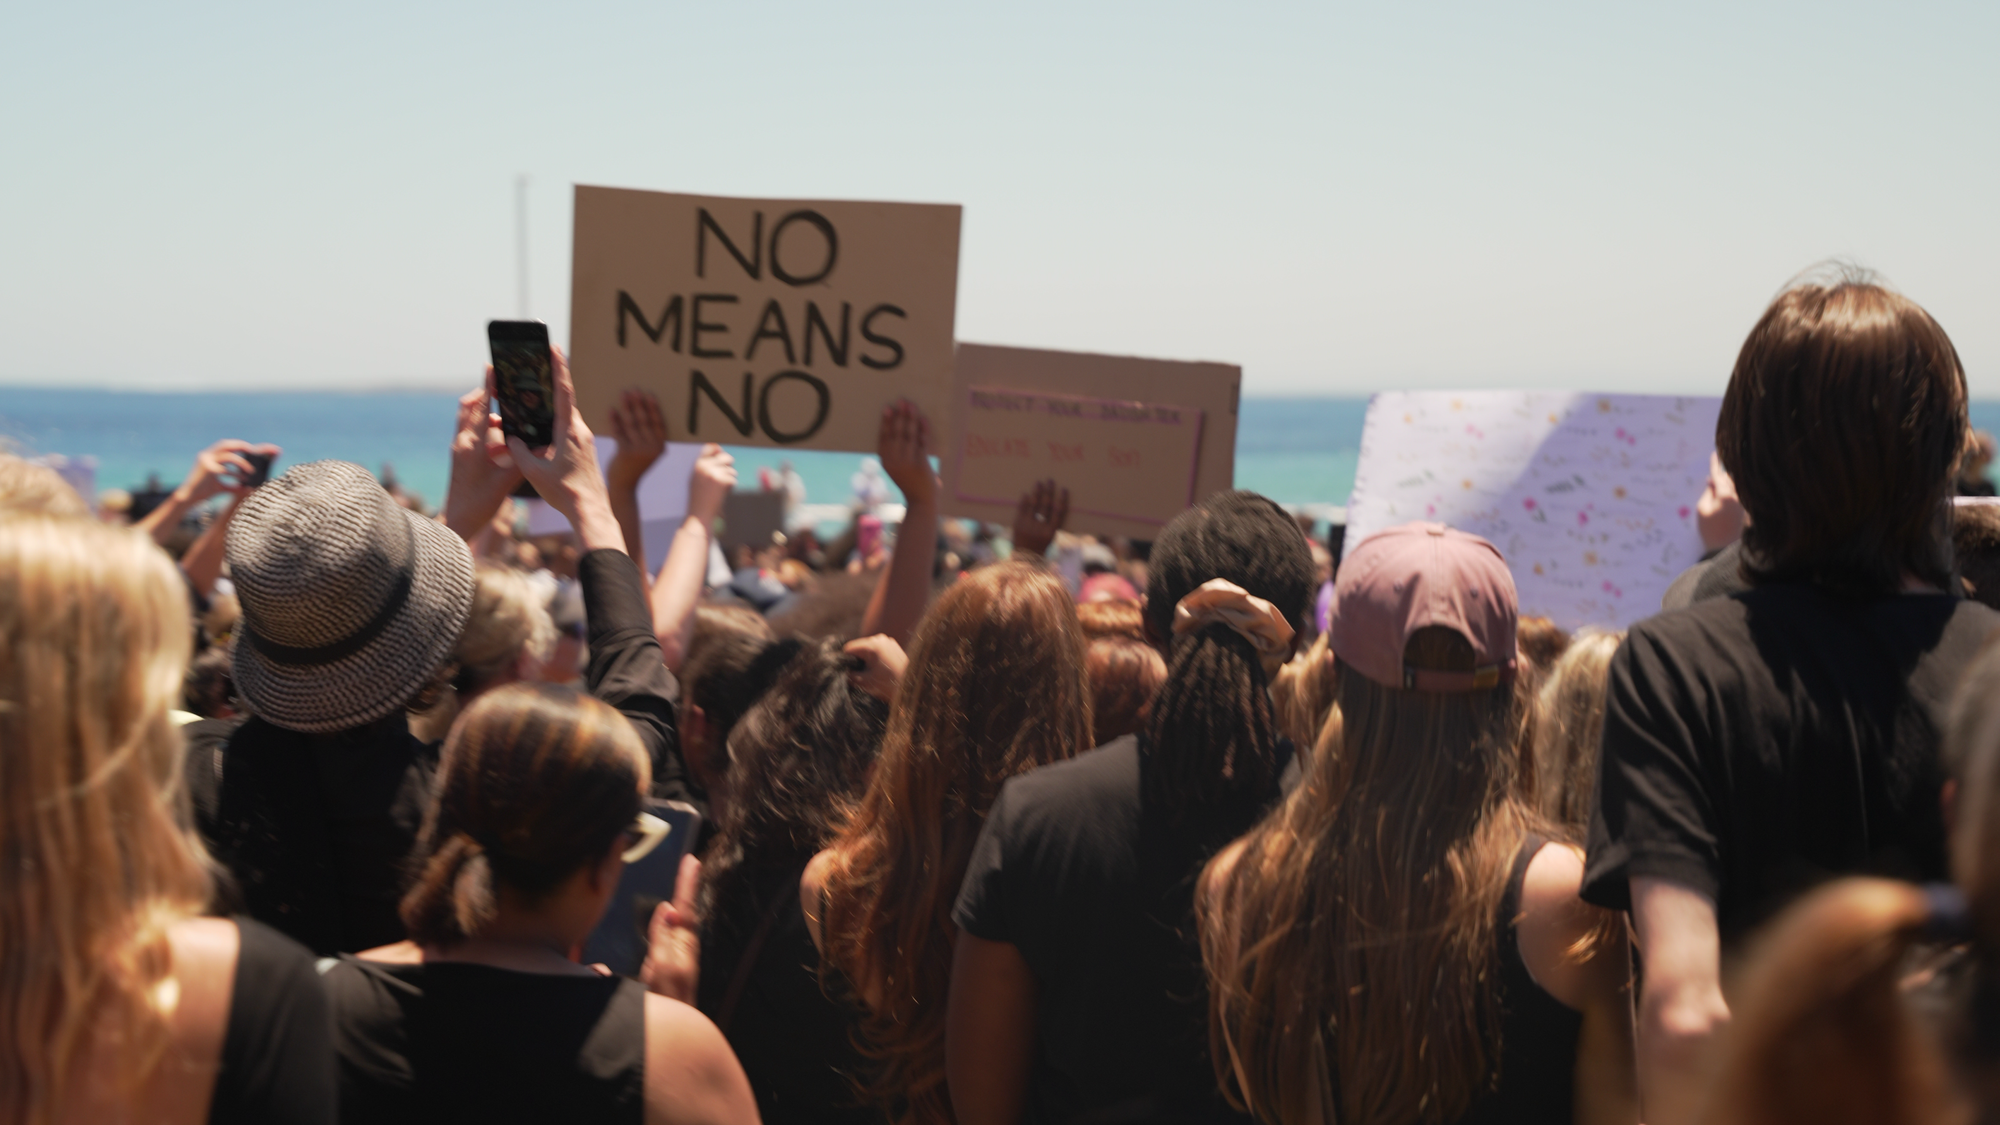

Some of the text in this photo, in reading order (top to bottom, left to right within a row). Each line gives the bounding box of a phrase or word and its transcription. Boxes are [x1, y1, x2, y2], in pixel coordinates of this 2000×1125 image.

[696, 207, 839, 287] NO
[615, 290, 908, 370] MEANS
[687, 369, 831, 444] NO
